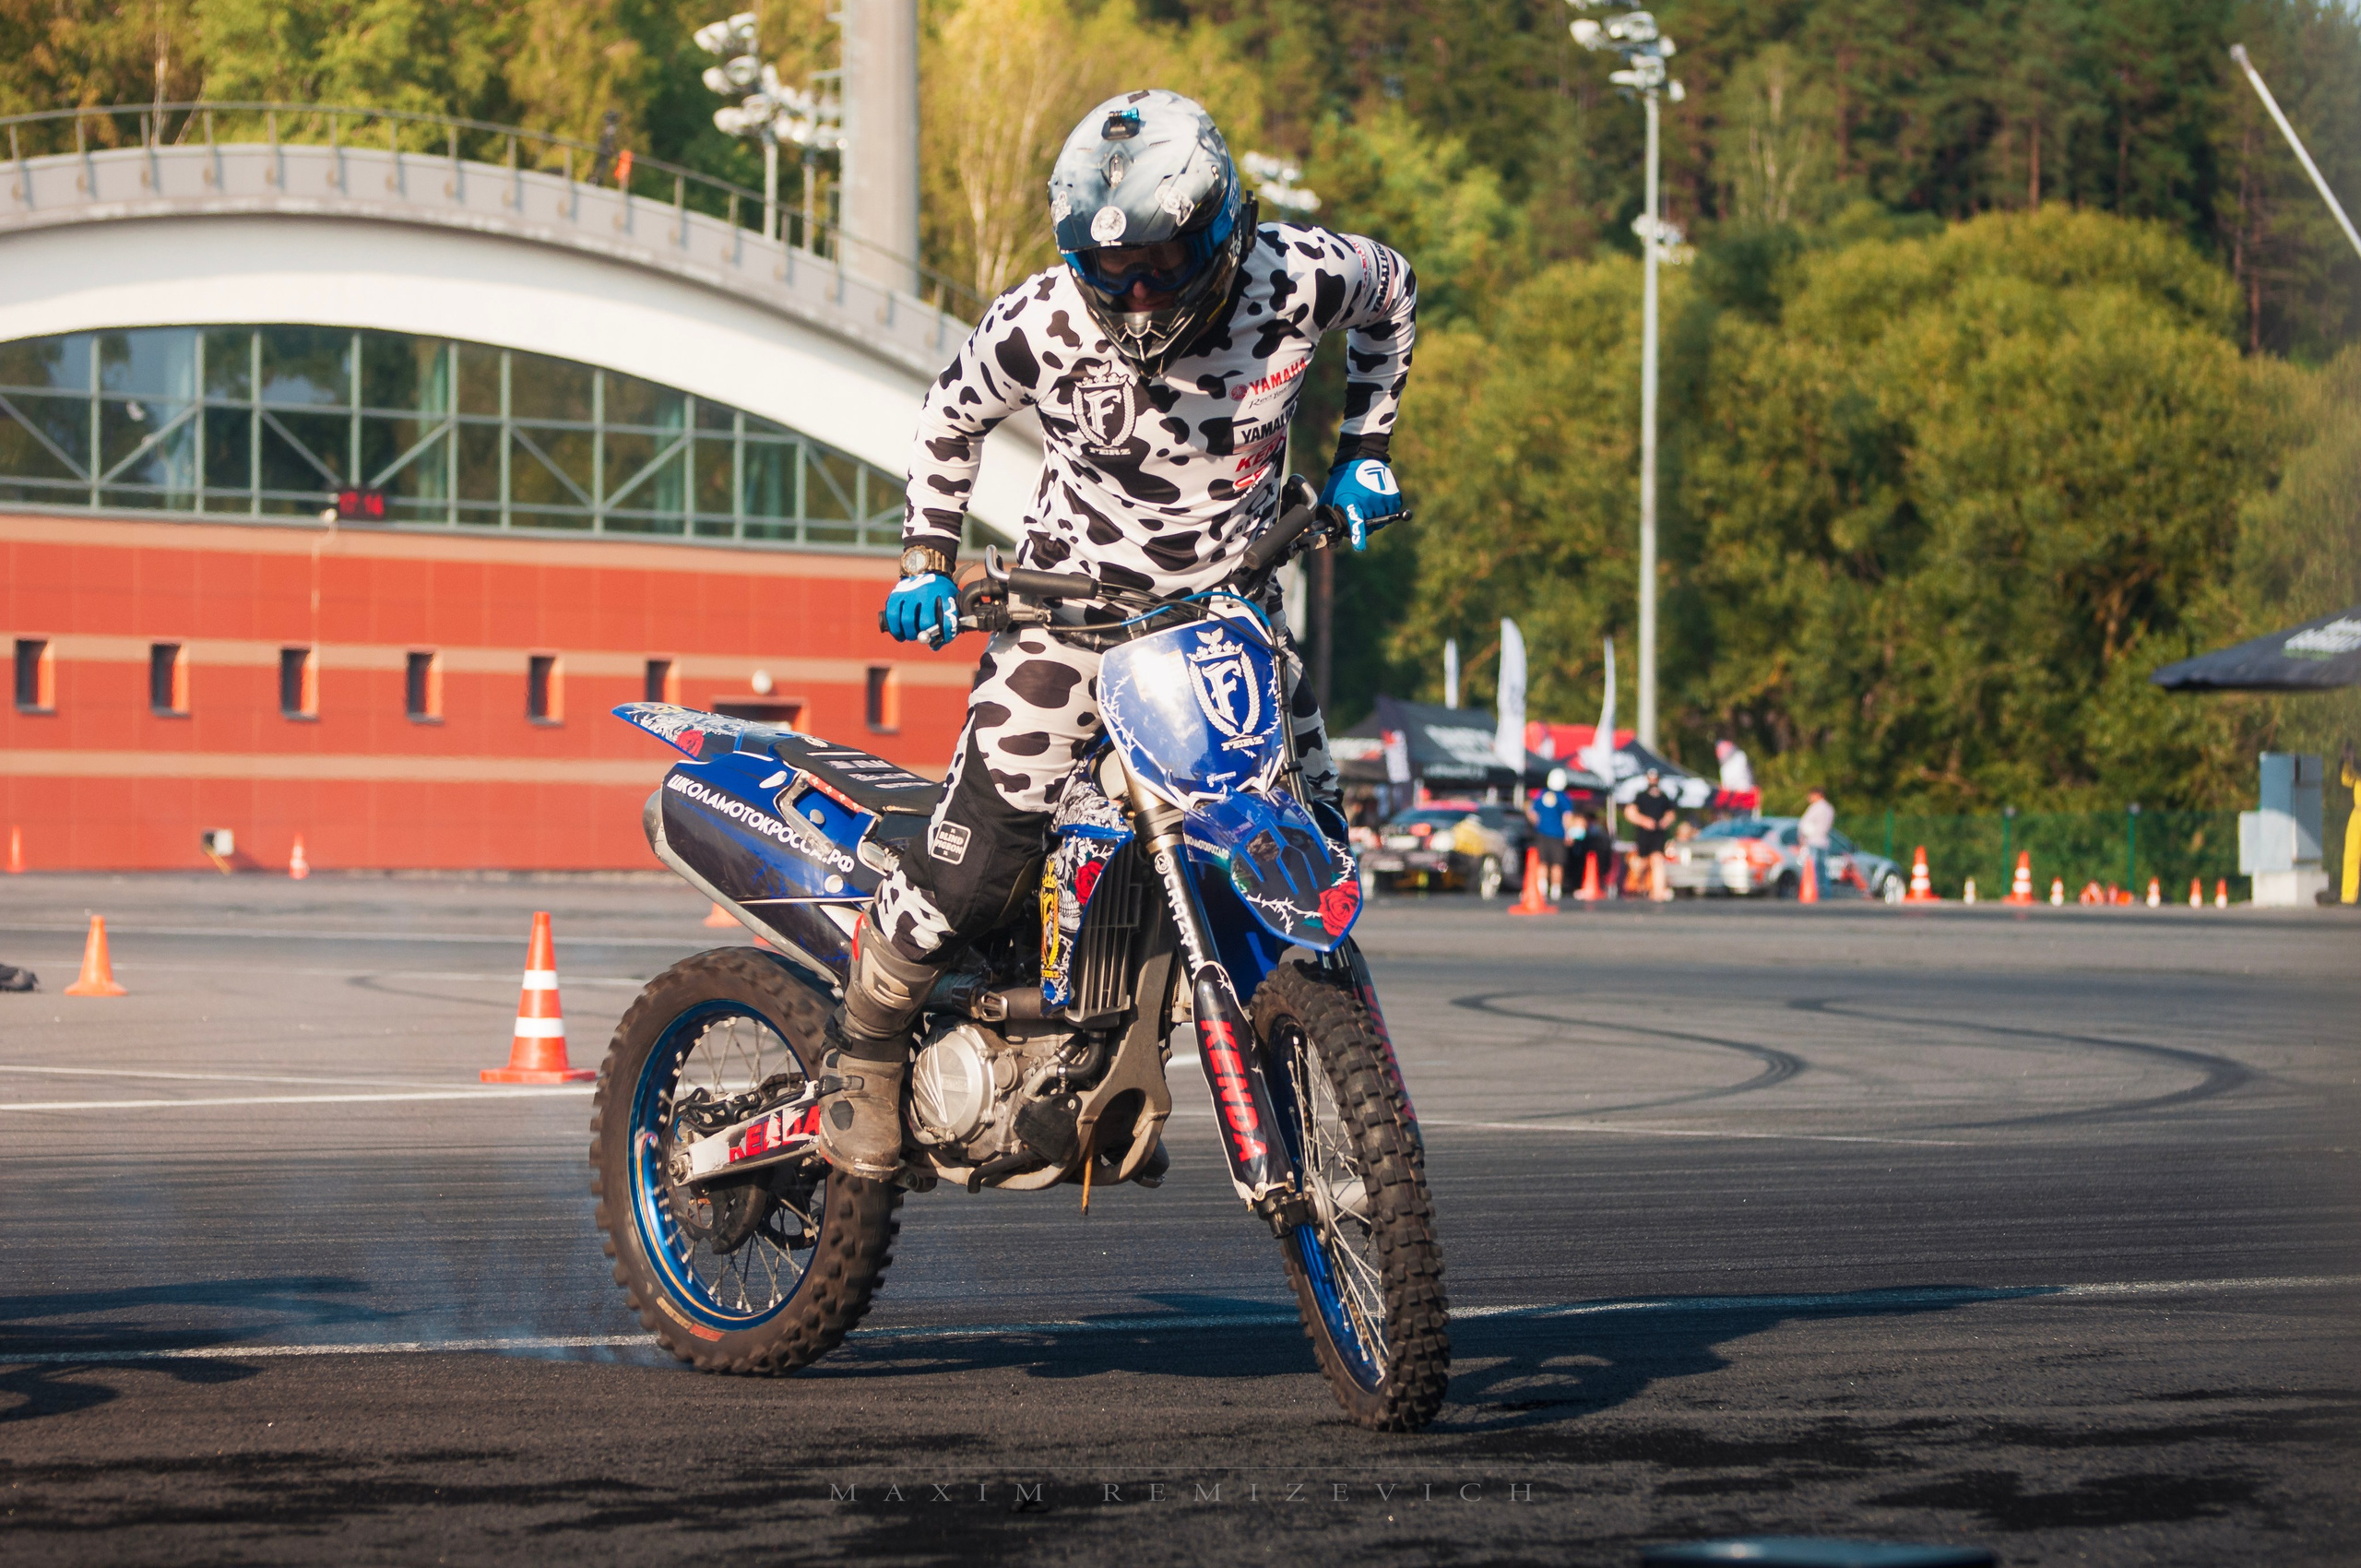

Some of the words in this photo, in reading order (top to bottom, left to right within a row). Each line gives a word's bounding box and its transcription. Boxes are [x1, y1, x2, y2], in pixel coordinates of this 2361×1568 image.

[1249, 356, 1308, 395] YAMAHA
[1235, 435, 1286, 472] KEN
[1220, 735, 1265, 752] FERZ
[939, 831, 965, 846] BLIND
[1200, 1020, 1267, 1162] KENDA
